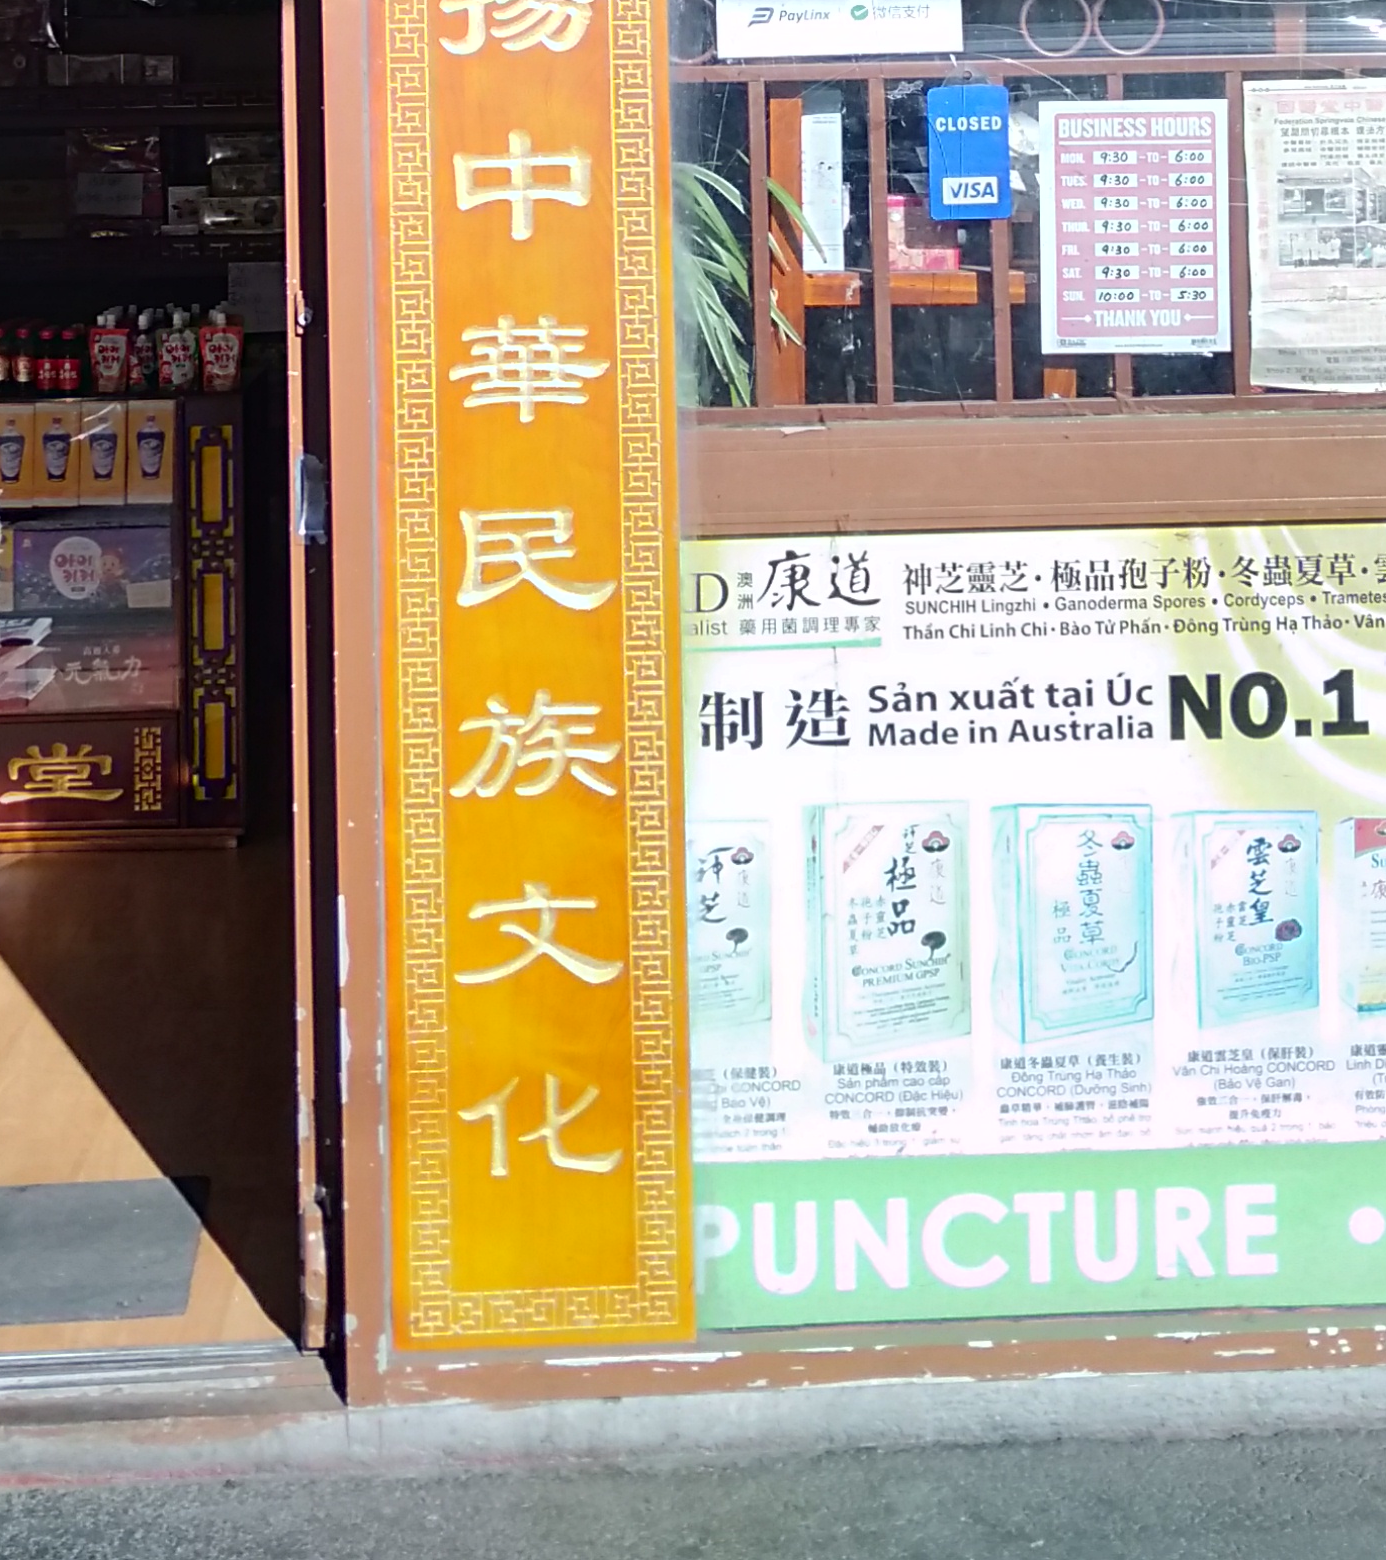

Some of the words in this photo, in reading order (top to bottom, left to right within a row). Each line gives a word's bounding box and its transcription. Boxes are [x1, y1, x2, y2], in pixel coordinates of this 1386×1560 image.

[778, 8, 831, 22] PayLinx
[871, 4, 931, 20] 微信支付
[935, 116, 1002, 132] CLOSED
[1058, 118, 1146, 139] BUSINESS
[1151, 117, 1212, 137] HOURS
[1100, 152, 1128, 163] 9:30
[1175, 151, 1205, 162] 6:00
[1100, 175, 1130, 186] 9:30
[1175, 175, 1205, 185] 6:00
[949, 183, 995, 199] VISA
[1101, 198, 1130, 208] 9:30
[1176, 197, 1207, 208] 6:00
[1102, 220, 1132, 232] 9:30
[1178, 220, 1209, 231] 6:00
[1102, 244, 1130, 255] 9:30
[1178, 243, 1207, 253] 6:00
[1102, 267, 1131, 278] 9:30
[1179, 266, 1207, 277] 6:00
[1098, 291, 1134, 302] 10:00
[1178, 290, 1207, 300] 5:30
[1094, 310, 1147, 327] THANK
[1151, 309, 1181, 326] YOU
[54, 553, 93, 568] 아이
[62, 568, 95, 584] 키커
[737, 572, 753, 610] 澳洲
[905, 599, 977, 615] SUNCHIH
[981, 598, 1036, 617] Lingzhi
[1055, 595, 1147, 611] Ganoderma
[1152, 594, 1206, 612] Spores
[1224, 593, 1304, 610] Cordyceps
[739, 615, 881, 636] 藥用菌調理專家
[949, 624, 977, 639] Chi
[980, 623, 1016, 638] Linh
[1021, 623, 1047, 638] Chi
[1276, 616, 1299, 635] Hạ
[1354, 612, 1385, 629] Vân
[868, 681, 938, 714] Sản
[949, 677, 1034, 710] xuất
[1046, 679, 1093, 717] tại
[1107, 673, 1153, 707] Úc
[1168, 669, 1370, 740] NO.1
[699, 688, 851, 751] 制造
[868, 722, 959, 747] Made
[969, 720, 997, 744] in
[1008, 714, 1154, 744] Australia
[1267, 1060, 1335, 1074] CONCORD
[825, 1091, 895, 1104] CONCORD
[997, 1086, 1066, 1099] CONCORD
